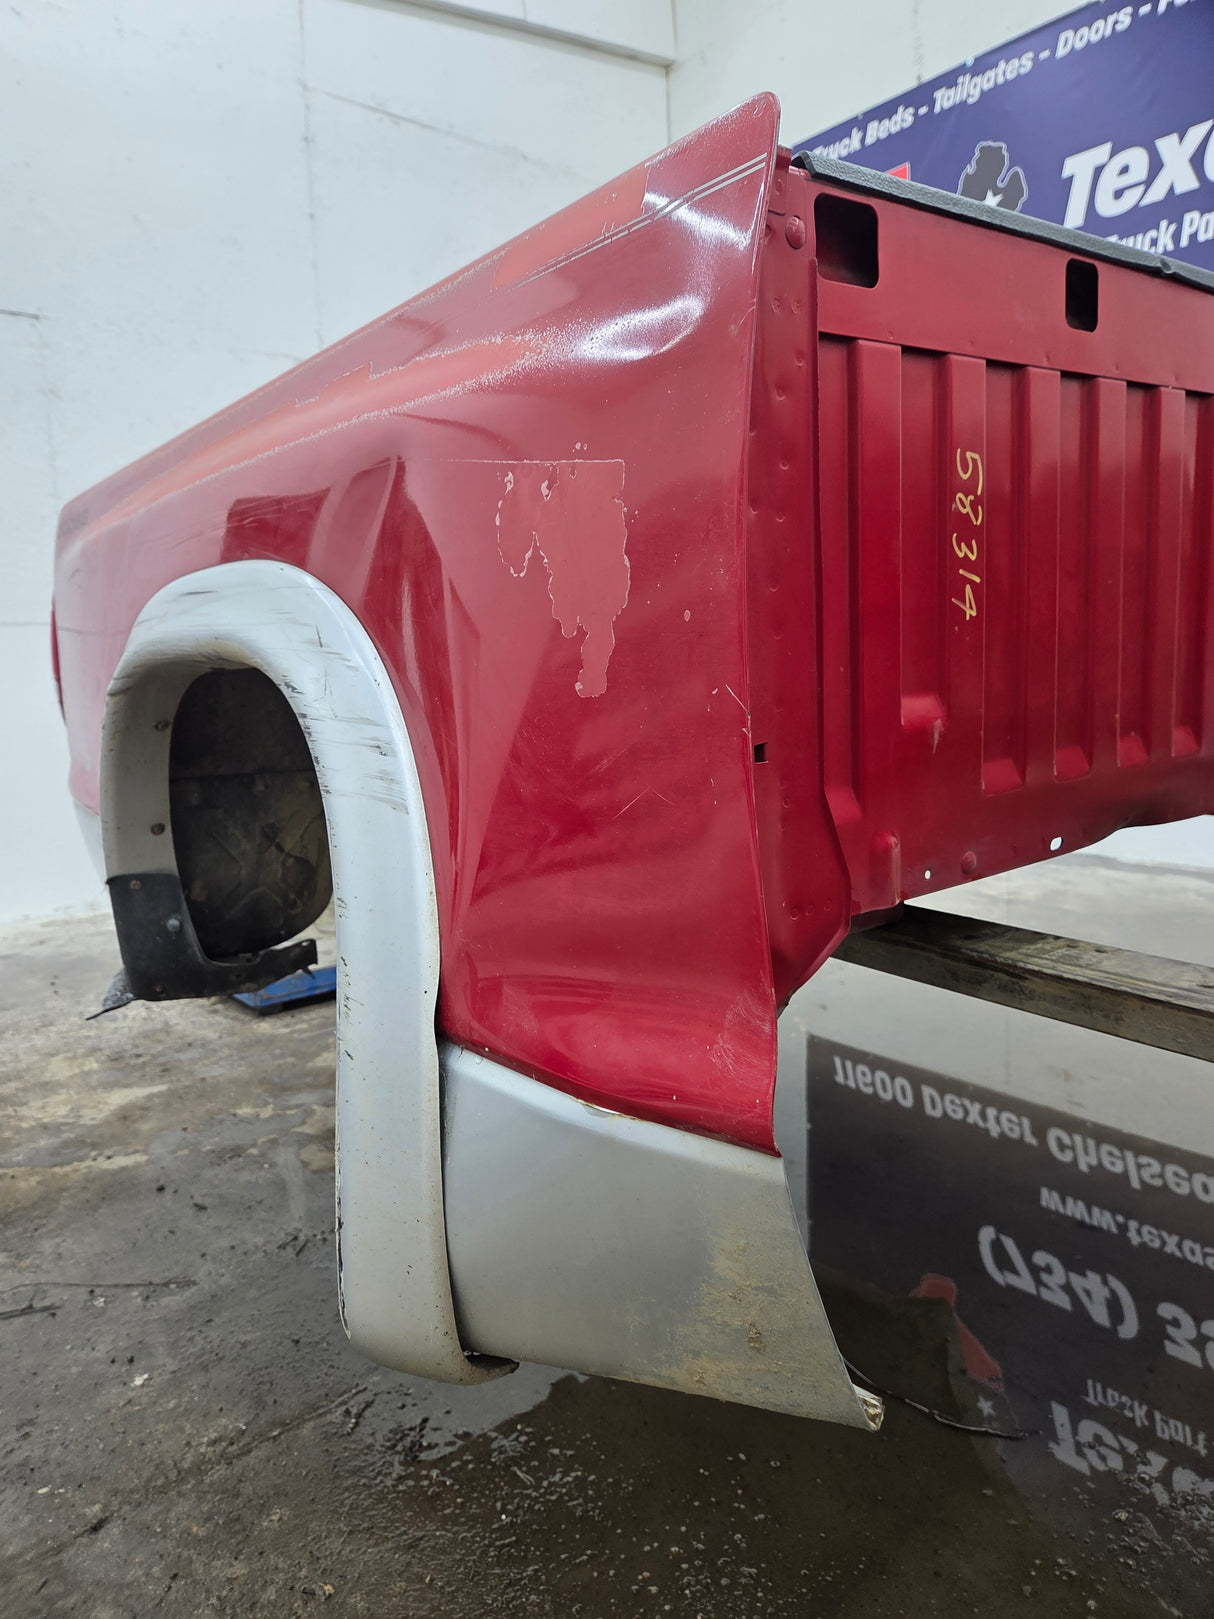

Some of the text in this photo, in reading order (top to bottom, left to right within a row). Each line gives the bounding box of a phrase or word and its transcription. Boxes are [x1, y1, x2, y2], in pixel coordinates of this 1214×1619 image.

[864, 104, 915, 147] Beds
[933, 51, 1034, 114] Tailgates
[1055, 6, 1132, 60] Doors
[1061, 118, 1214, 228] Tex
[952, 448, 983, 620] 58314
